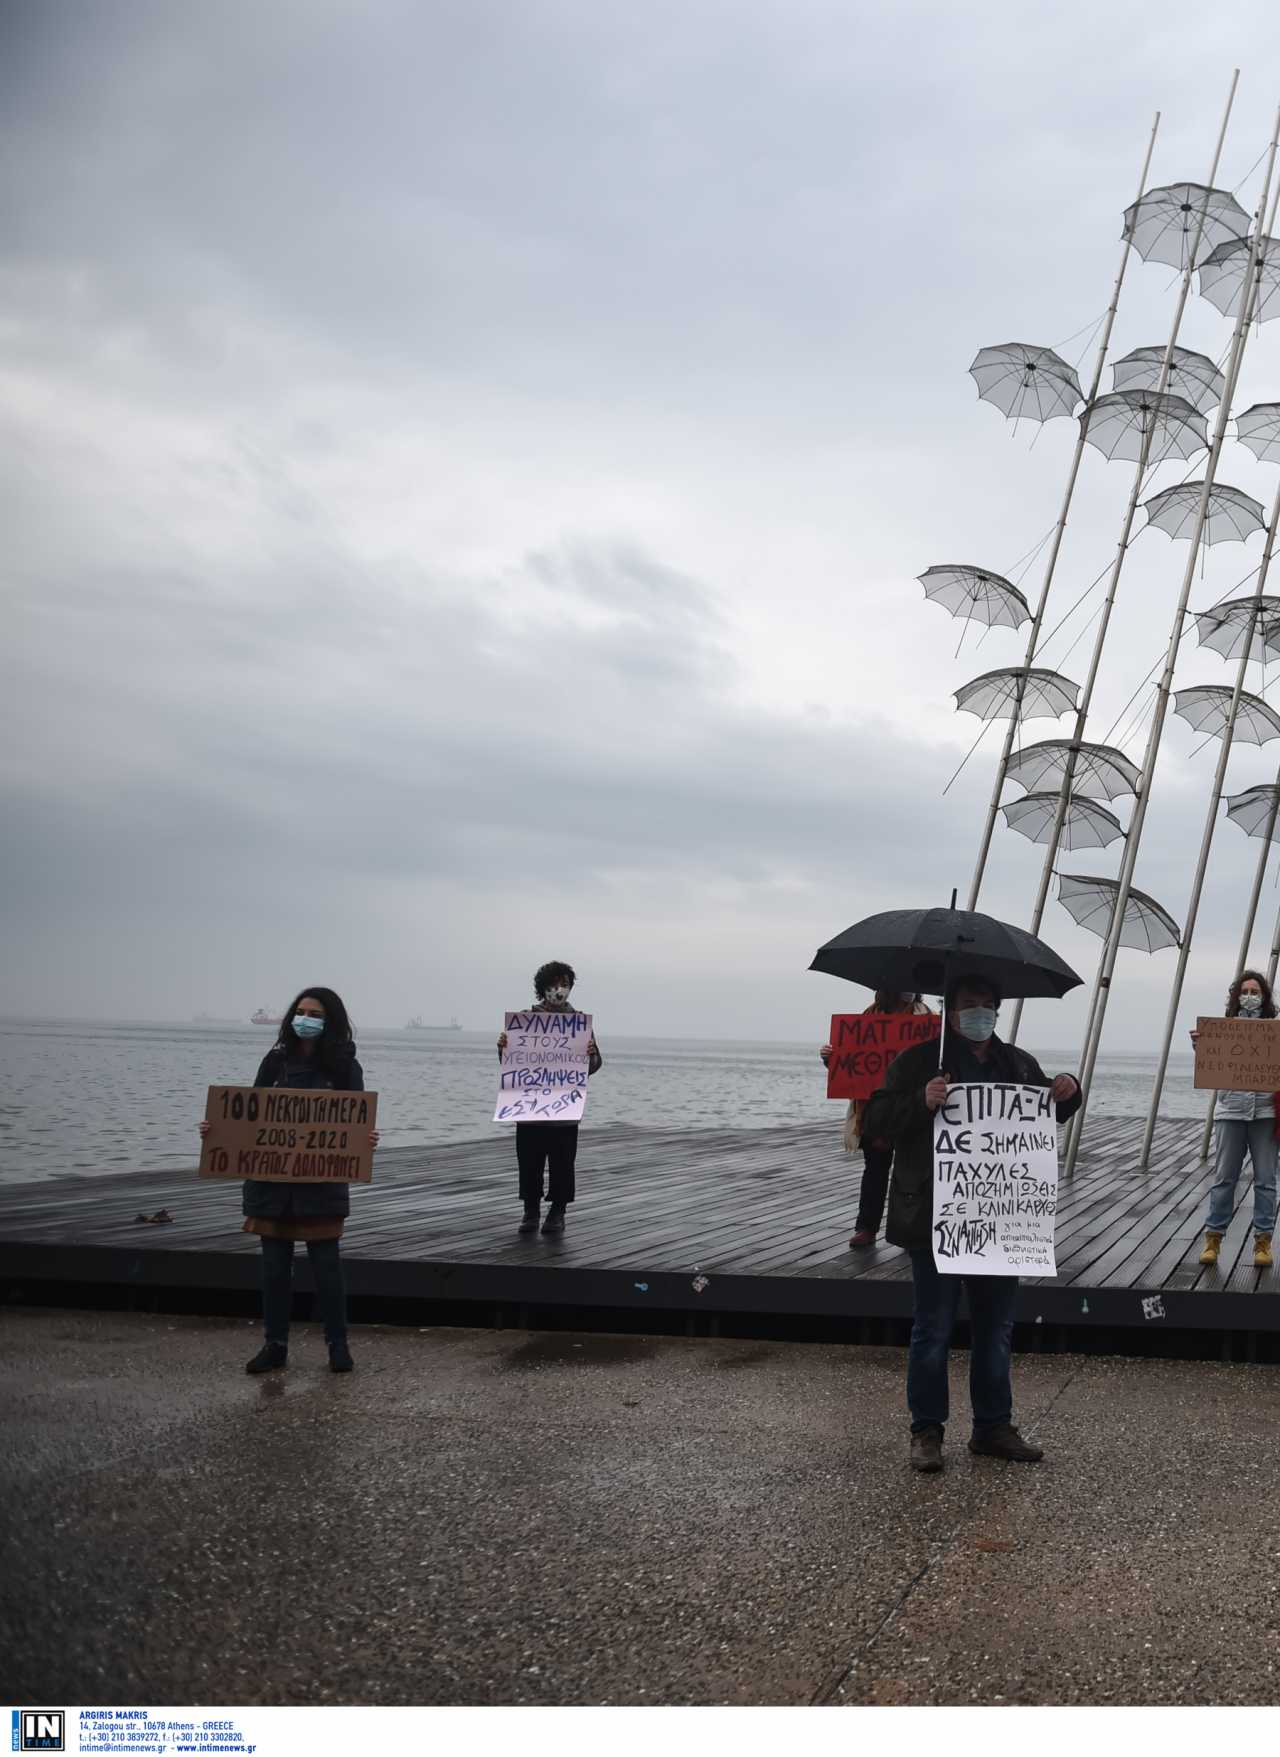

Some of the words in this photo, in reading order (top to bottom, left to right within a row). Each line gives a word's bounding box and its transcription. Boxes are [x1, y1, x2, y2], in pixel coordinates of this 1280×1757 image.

[507, 1014, 587, 1038] ΔΥΝΑΜΗ
[838, 1019, 892, 1047] ΜΑΤ
[517, 1035, 571, 1050] ΣΤΟΥΣ
[221, 1090, 260, 1122] 100
[942, 1085, 1052, 1125] ΕΠΙΤΑΞΗ
[935, 1129, 973, 1154] ΔΕ
[981, 1131, 1055, 1156] ΣΗΜΑΙΝΕΙ
[209, 1147, 228, 1172] ΤΟ
[237, 1150, 292, 1176] ΚΡΑΤΟΣ
[292, 1153, 361, 1179] ΔΟΛΟΦΟΝΕΙ
[939, 1160, 1037, 1182] ΠΑΧΥΛΕΣ
[952, 1181, 1056, 1199] ΑΠΟΖΗΜΙΩΣΕΙΣ
[939, 1202, 967, 1216] ΣΕ
